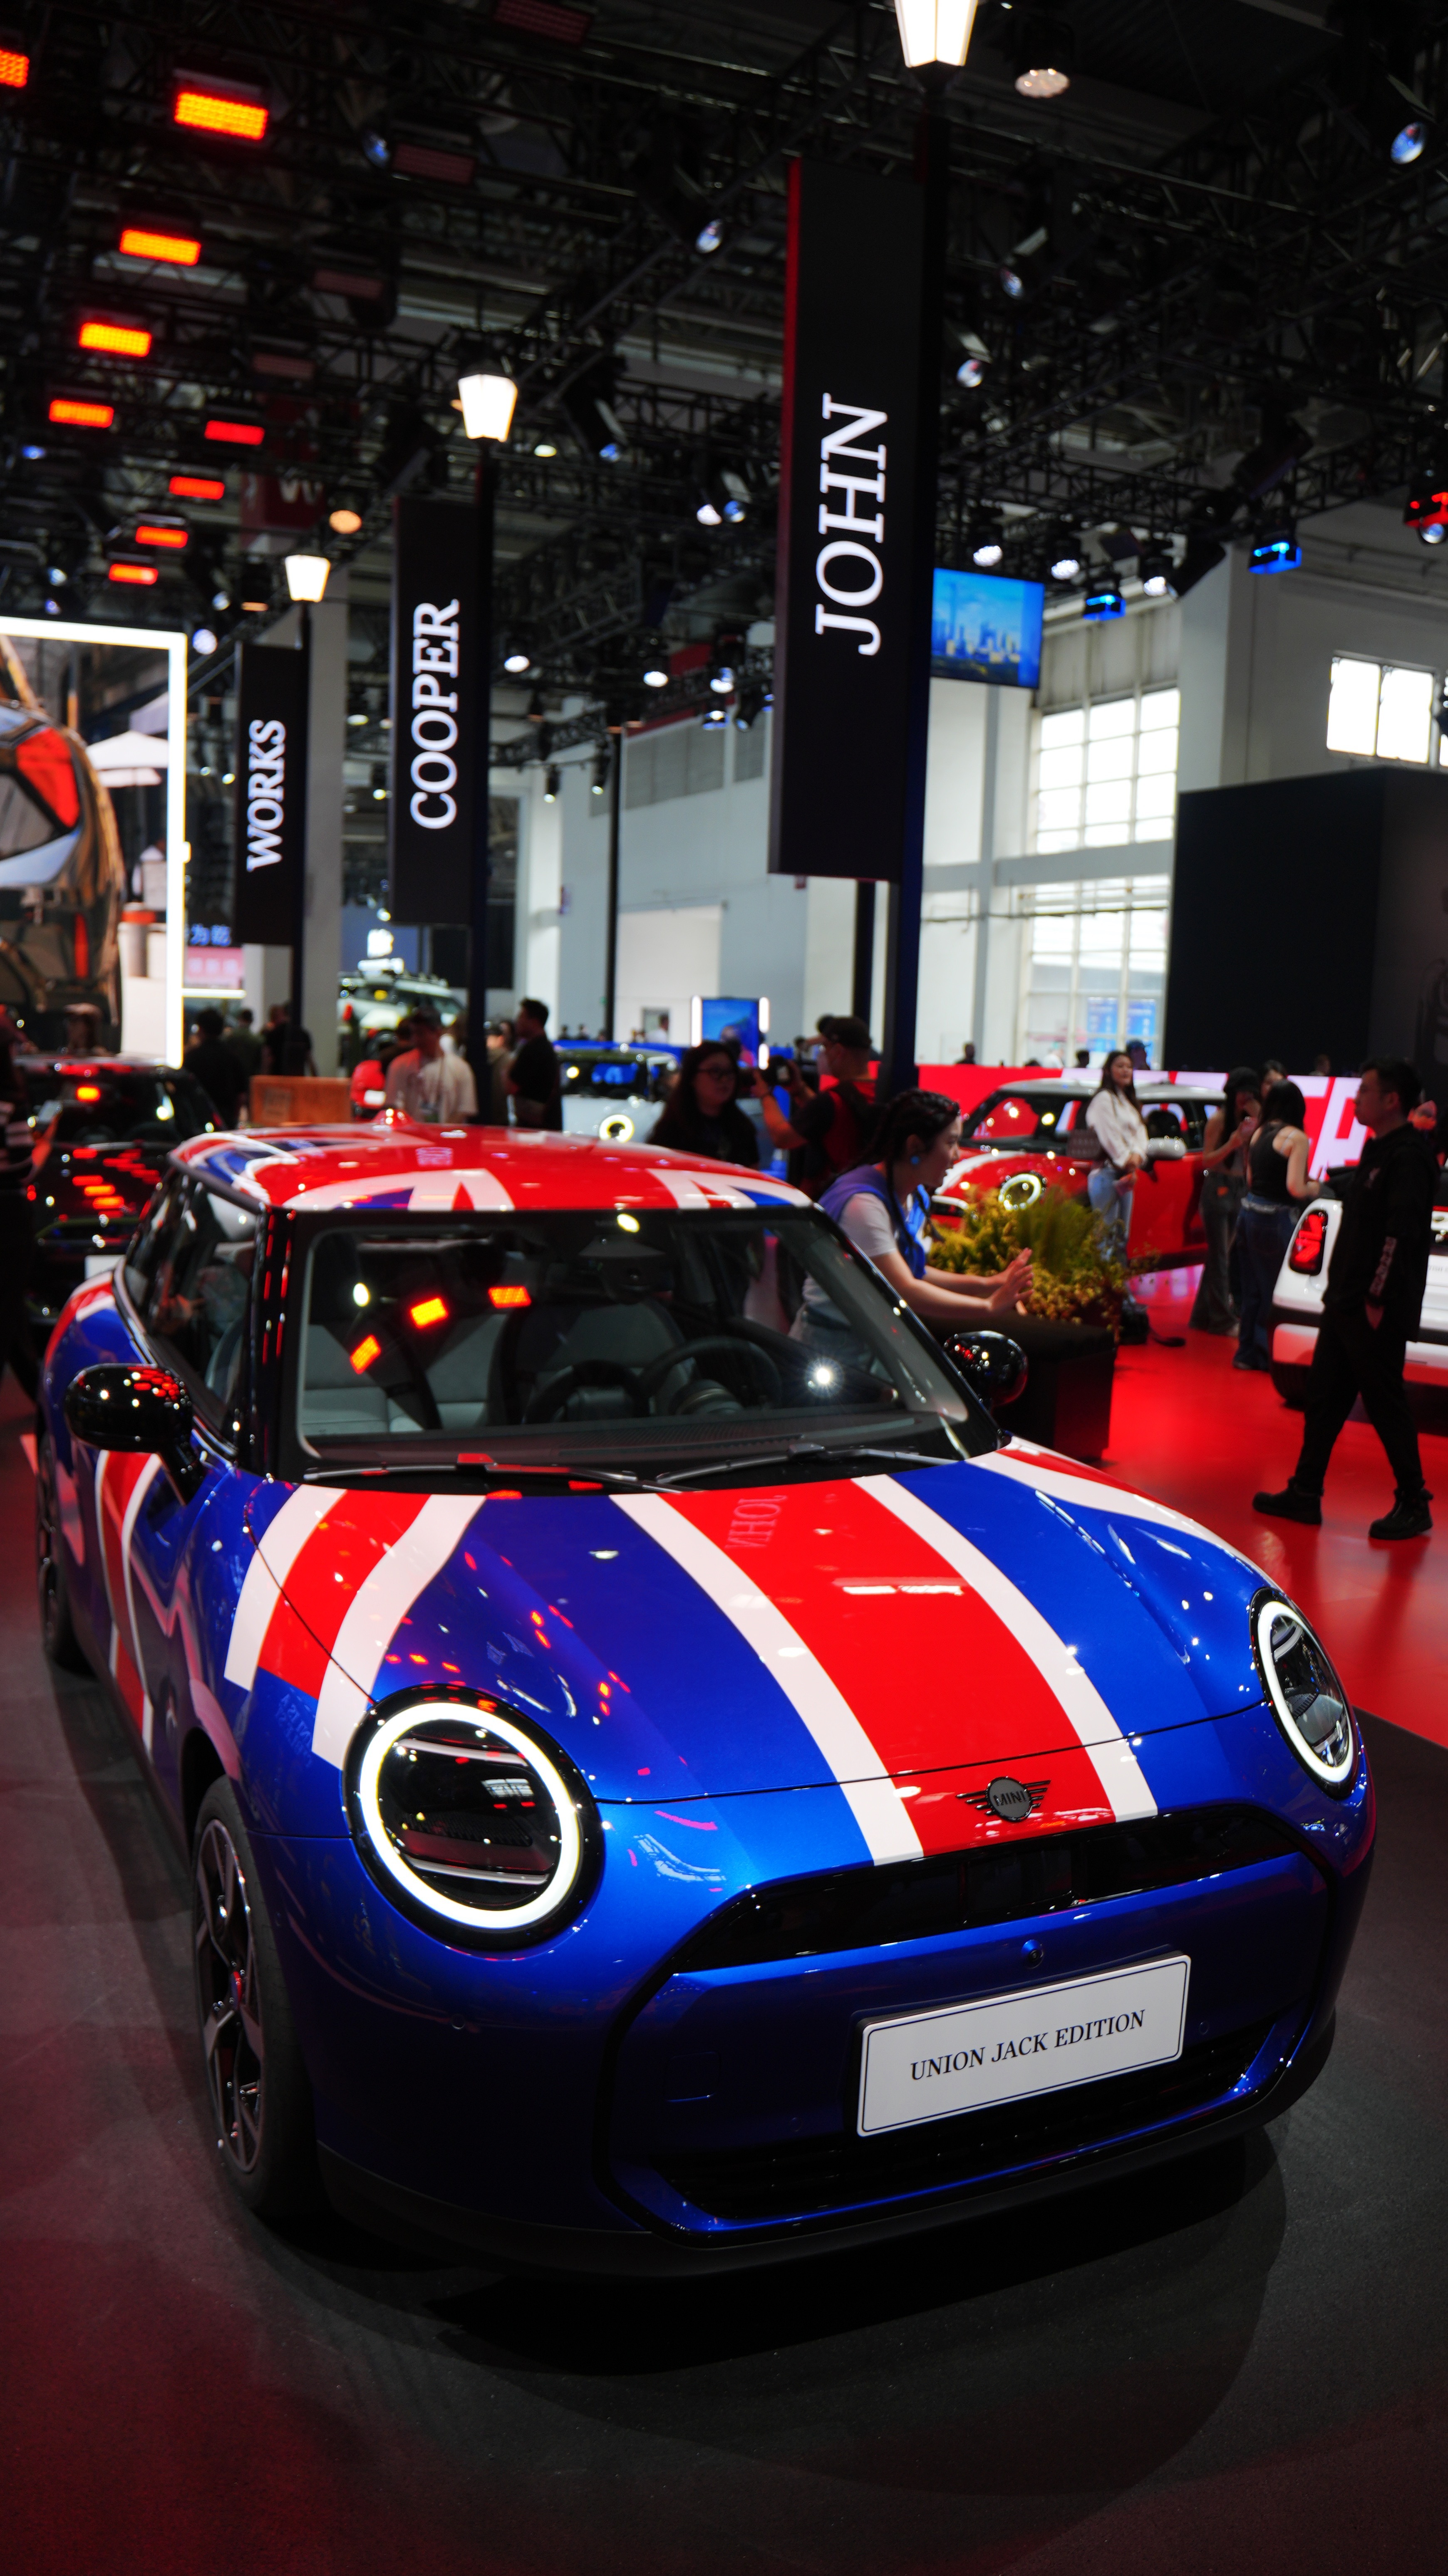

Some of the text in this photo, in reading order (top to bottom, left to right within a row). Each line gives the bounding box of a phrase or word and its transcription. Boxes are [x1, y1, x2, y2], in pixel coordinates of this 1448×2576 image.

[815, 392, 888, 656] JOHN
[410, 599, 460, 829] COOPER
[247, 719, 286, 872] WORKS
[993, 1791, 1026, 1806] MINI
[910, 2009, 1145, 2080] UNION JACK EDITION
